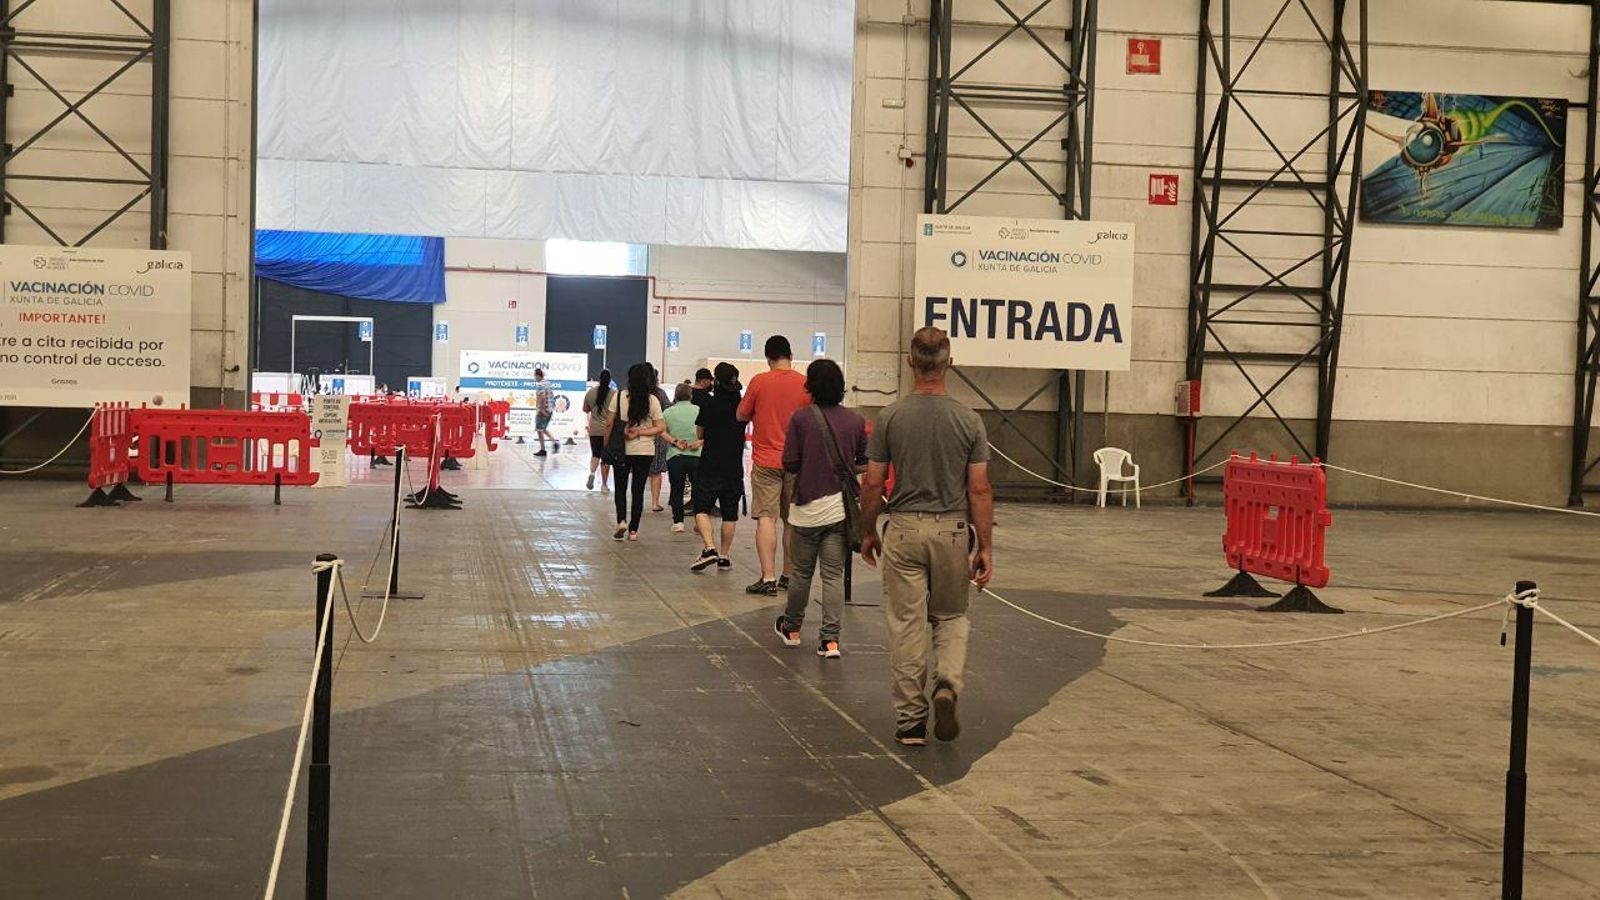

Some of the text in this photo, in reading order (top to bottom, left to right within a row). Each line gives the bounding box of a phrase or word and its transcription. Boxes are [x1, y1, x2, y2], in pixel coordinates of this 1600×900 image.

[1088, 231, 1128, 244] galicia
[978, 249, 1102, 265] VACINACIÓN COVID
[136, 260, 184, 274] galicia
[1023, 265, 1058, 273] GALICIA
[10, 281, 154, 297] VACINACIÓN COVID
[9, 296, 44, 304] XUNTA
[63, 297, 103, 306] GALICIA
[19, 312, 106, 324] IMPORTANTE!
[925, 297, 1123, 343] ENTRADA
[22, 338, 32, 347] a
[36, 336, 66, 348] cita
[71, 337, 133, 350] recibida
[139, 341, 164, 353] por
[24, 353, 77, 365] control
[82, 354, 102, 365] de
[107, 356, 166, 367] acceso.
[488, 360, 549, 370] VACINACIÓN
